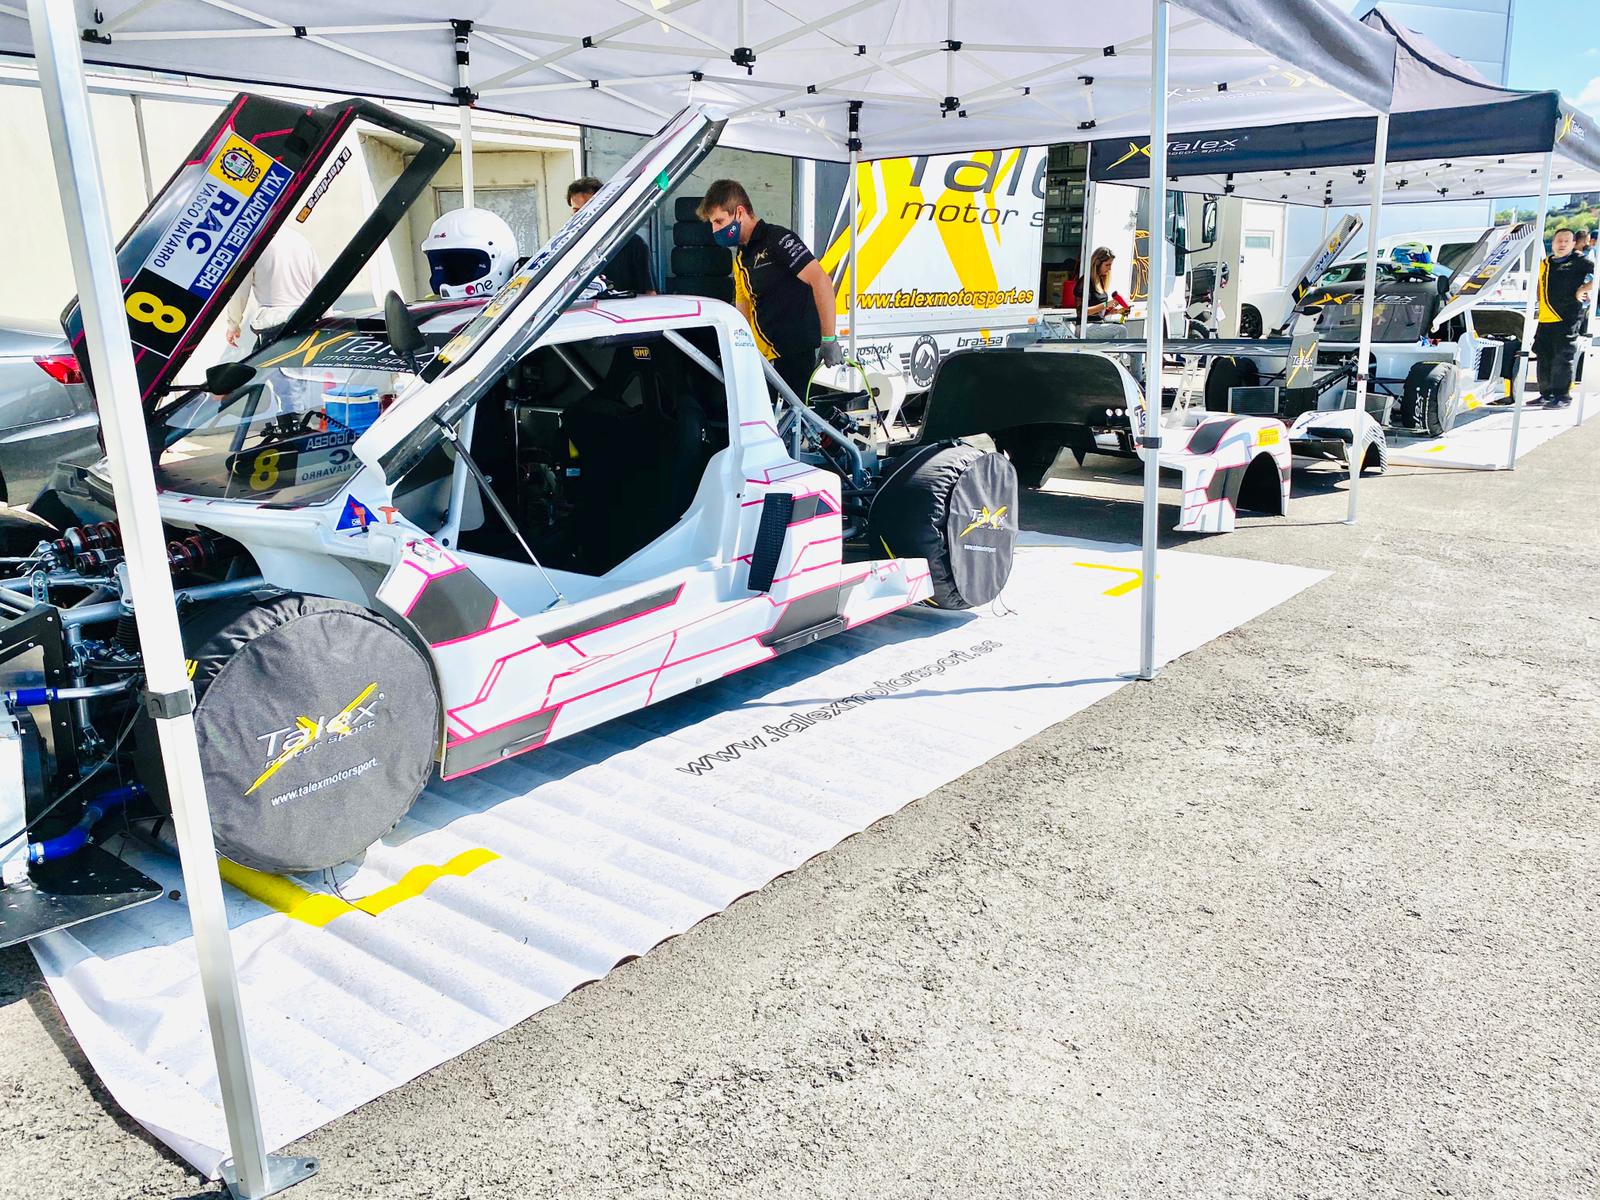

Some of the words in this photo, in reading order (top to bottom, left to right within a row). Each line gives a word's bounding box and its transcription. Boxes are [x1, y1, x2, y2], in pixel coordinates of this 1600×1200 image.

[186, 190, 240, 254] RAC
[187, 182, 218, 218] VASCO
[223, 191, 269, 248] JAIZKIBEL
[900, 201, 1019, 226] motor
[153, 218, 193, 268] NAVARRO
[195, 246, 236, 290] IGOERA
[125, 291, 187, 333] 8
[845, 286, 1034, 311] www.talexmotorsport.es
[957, 335, 1004, 348] brassa
[257, 700, 378, 757] Talex
[675, 638, 1004, 777] www.talexmotorsport.es
